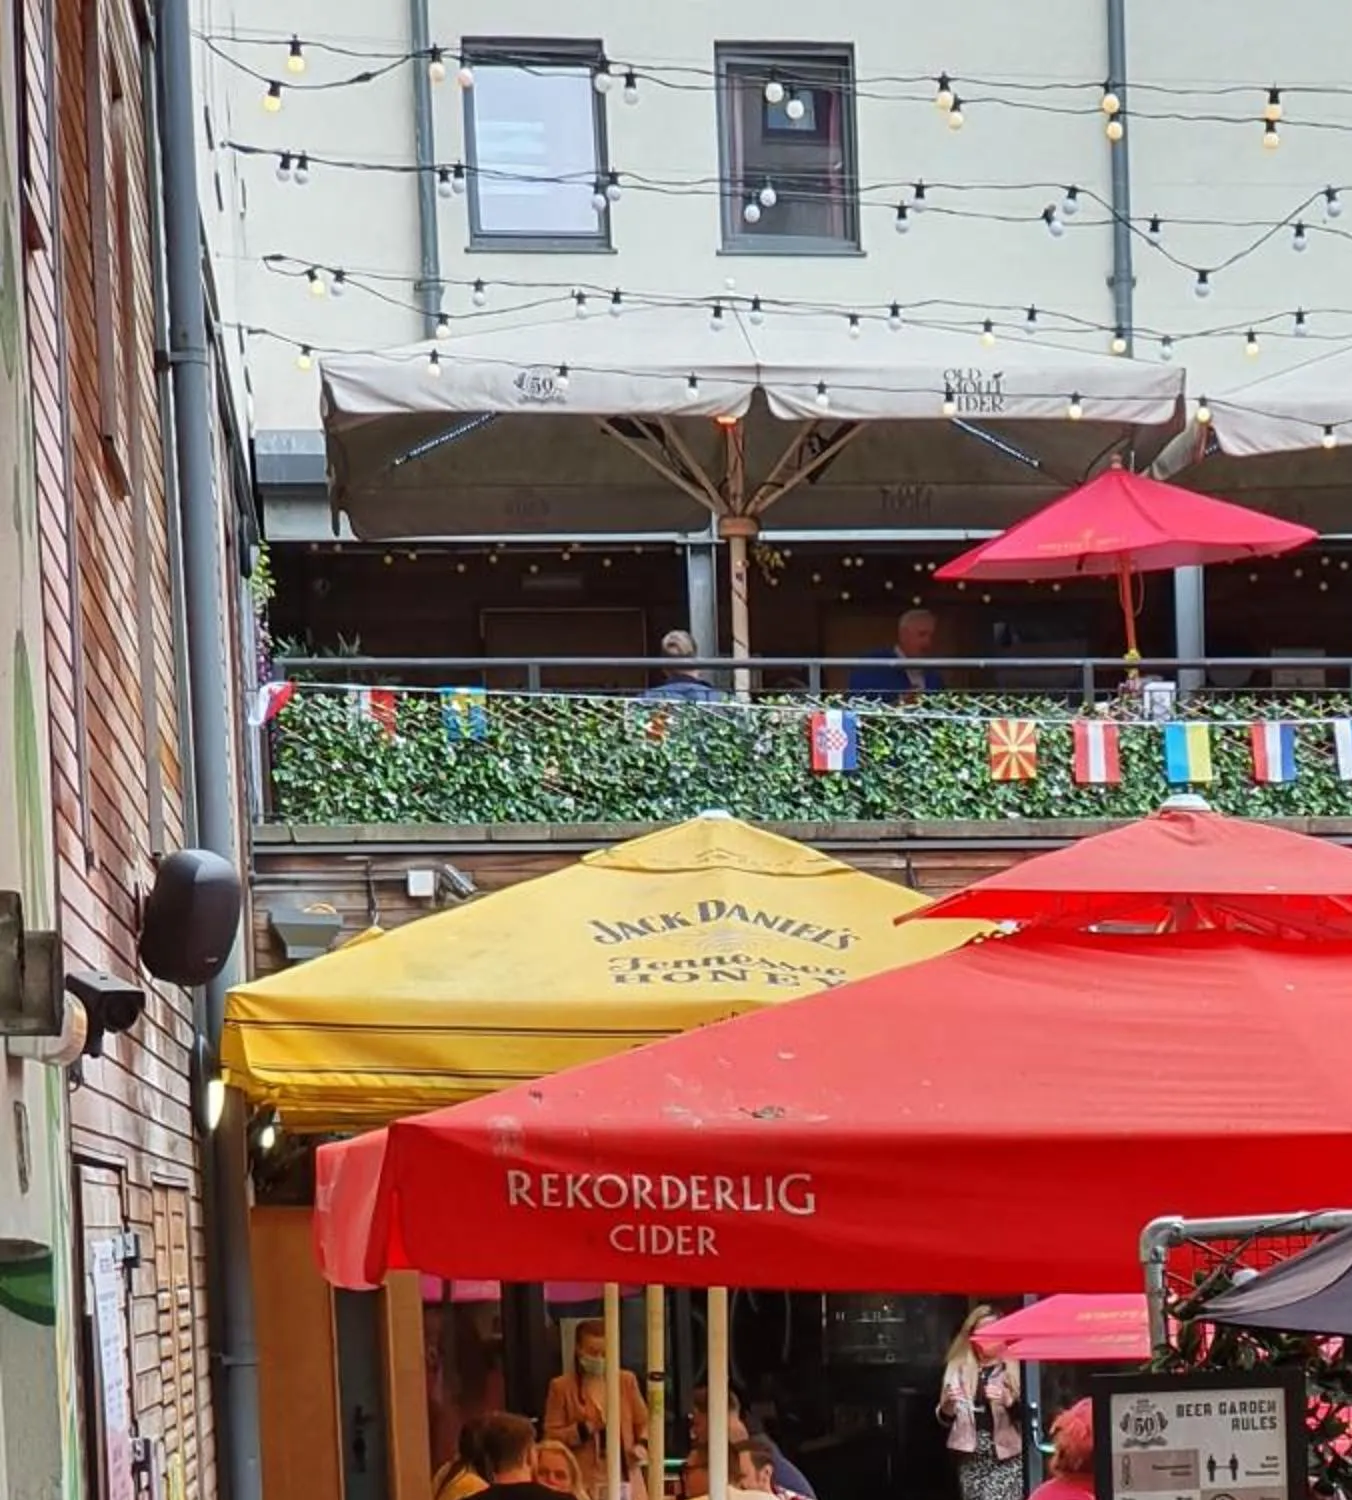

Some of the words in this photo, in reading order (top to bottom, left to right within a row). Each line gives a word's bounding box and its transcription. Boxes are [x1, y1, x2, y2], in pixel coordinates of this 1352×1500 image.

[943, 367, 982, 381] OLD
[943, 395, 1004, 413] IDER
[587, 910, 693, 946] JACK
[613, 968, 850, 988] HONEY
[506, 1169, 817, 1216] REKORDERLIG
[609, 1224, 719, 1256] CIDER
[1176, 1403, 1212, 1418] BEER
[1219, 1400, 1277, 1414] GARDEN
[1231, 1416, 1277, 1431] RULES
